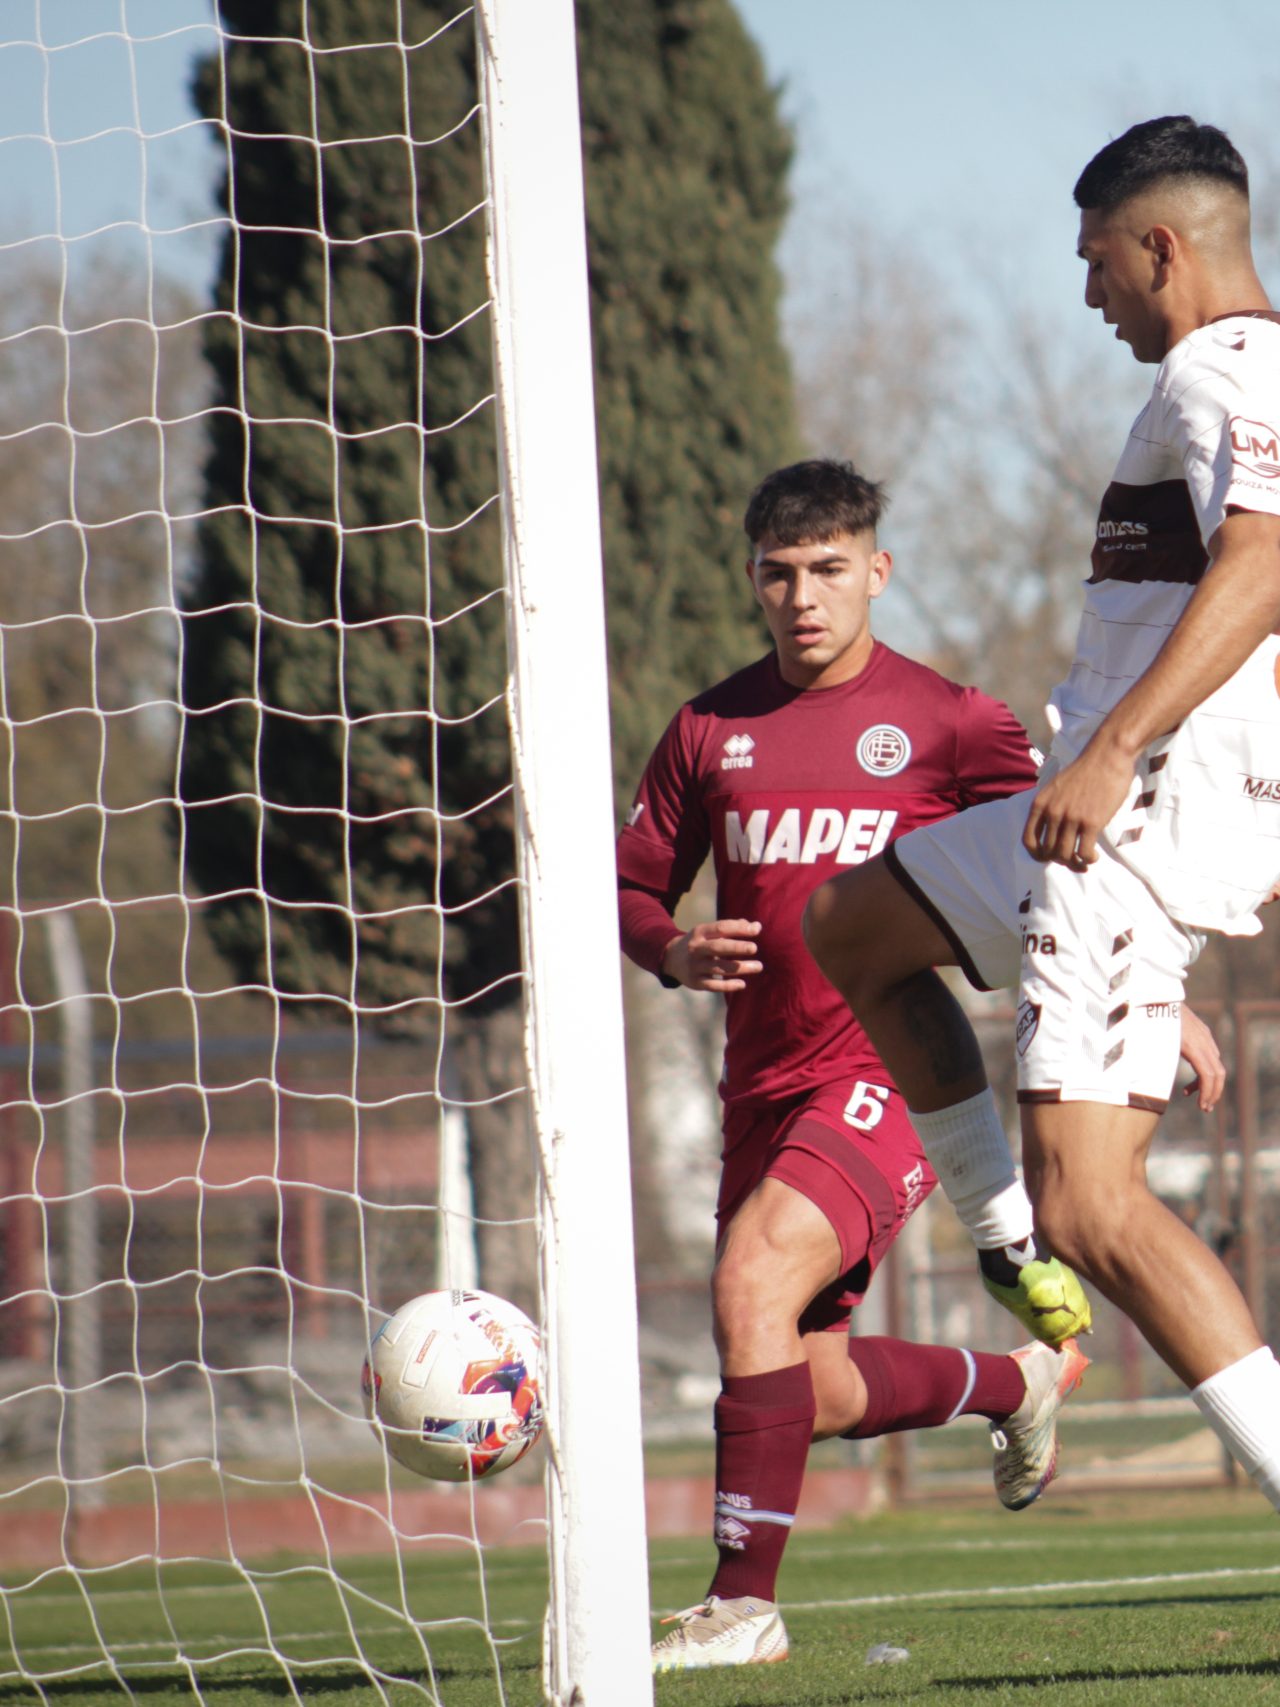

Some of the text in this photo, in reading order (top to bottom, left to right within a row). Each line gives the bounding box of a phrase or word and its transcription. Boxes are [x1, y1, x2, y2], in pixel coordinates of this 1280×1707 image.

[1230, 430, 1278, 462] UM
[725, 808, 898, 864] MAPEI
[1020, 924, 1057, 955] ina
[843, 1080, 890, 1131] 6
